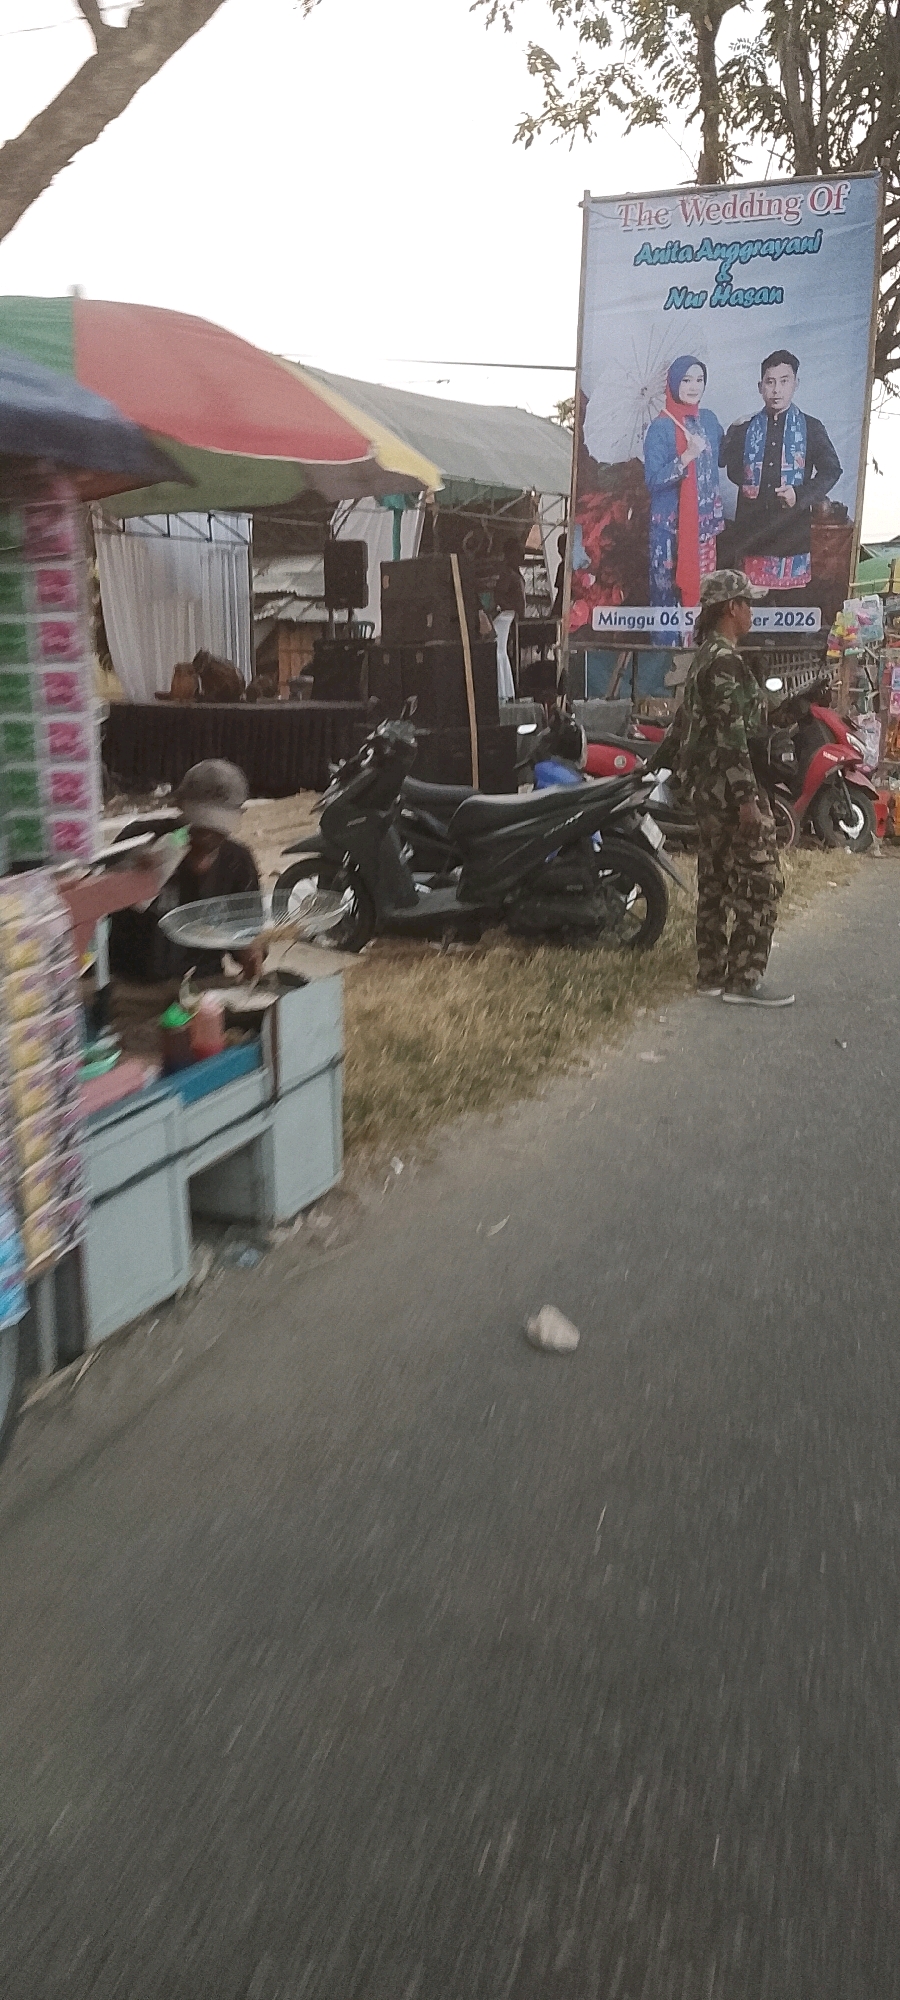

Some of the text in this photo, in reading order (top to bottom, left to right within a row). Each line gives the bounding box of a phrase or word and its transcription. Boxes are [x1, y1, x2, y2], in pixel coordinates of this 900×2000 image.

[618, 183, 849, 230] The Wedding Of
[634, 229, 823, 266] Anita Anggrayani
[715, 260, 733, 284] &
[663, 282, 784, 310] Nur Hasan
[598, 611, 655, 629] Minggu
[660, 611, 679, 626] 06
[774, 611, 816, 626] 2026
